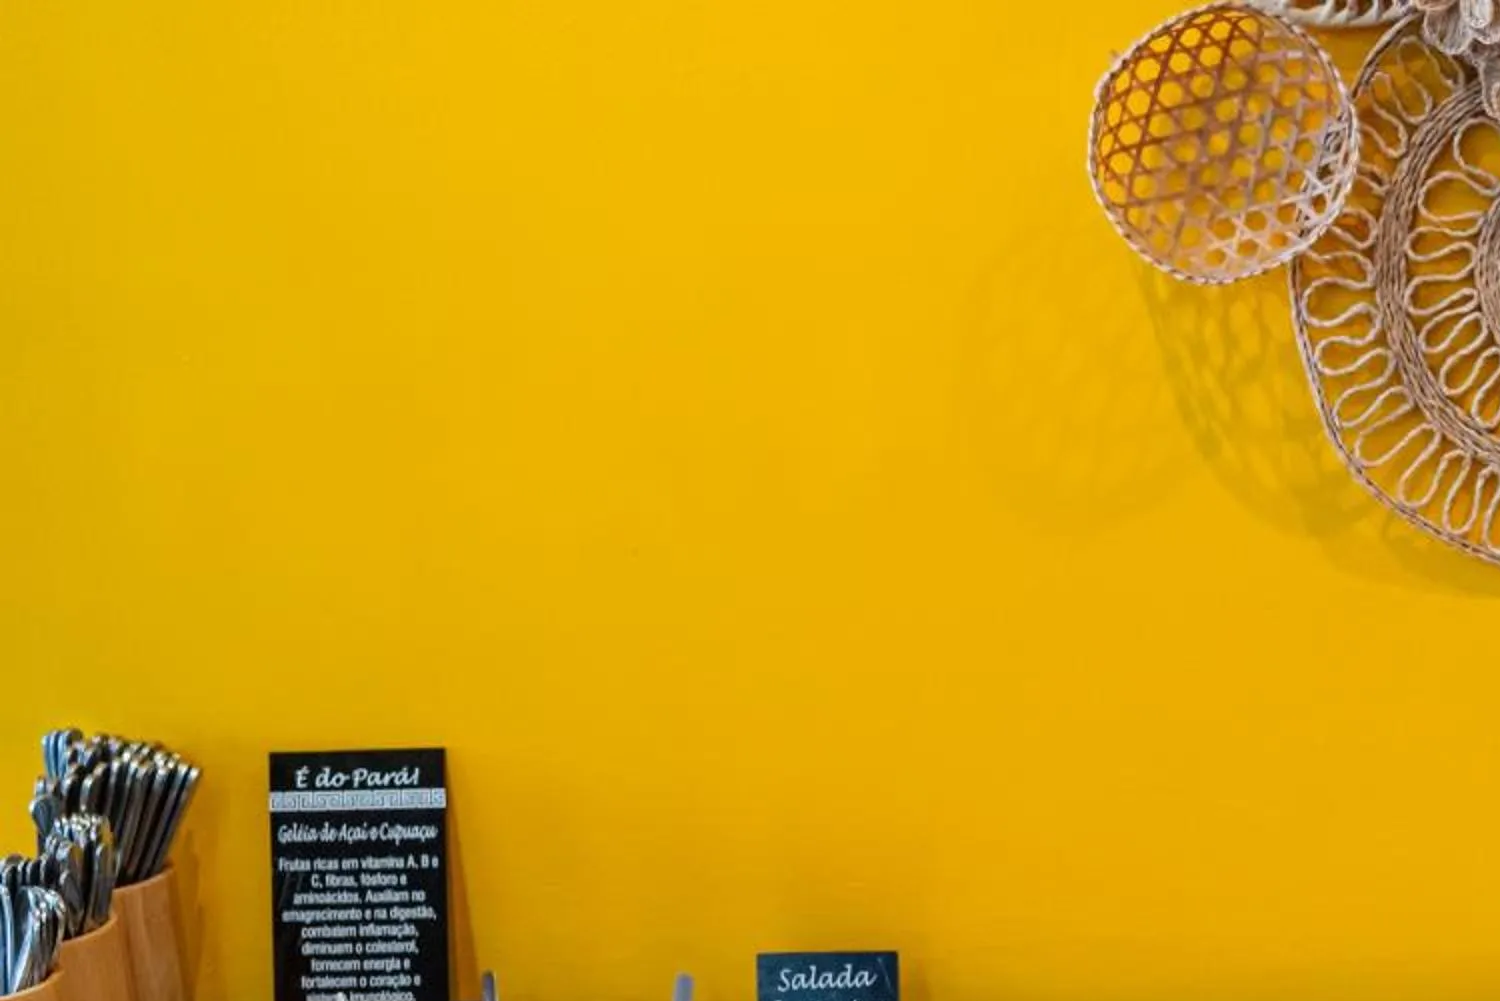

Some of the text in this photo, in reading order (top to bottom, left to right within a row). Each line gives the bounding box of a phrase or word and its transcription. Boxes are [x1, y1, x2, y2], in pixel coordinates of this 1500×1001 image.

[295, 765, 419, 789] É do Pará!
[320, 821, 338, 843] de
[369, 826, 379, 841] e
[379, 821, 438, 846] Cupuaçu
[279, 856, 311, 872] Frutas
[313, 858, 339, 870] ricas
[341, 858, 359, 870] em
[407, 853, 419, 870] A,
[431, 856, 439, 869] e
[311, 873, 323, 888] C,
[399, 874, 408, 886] e
[365, 889, 409, 903] Auxiliam
[411, 889, 426, 902] no
[281, 905, 437, 924] emagrecimento e na digestão,
[301, 941, 353, 956] diminuem
[355, 942, 363, 954] o
[311, 957, 411, 972] fornecem energia e
[359, 976, 367, 988] o
[369, 974, 412, 989] coração
[413, 974, 421, 986] e
[777, 963, 878, 992] Salada
